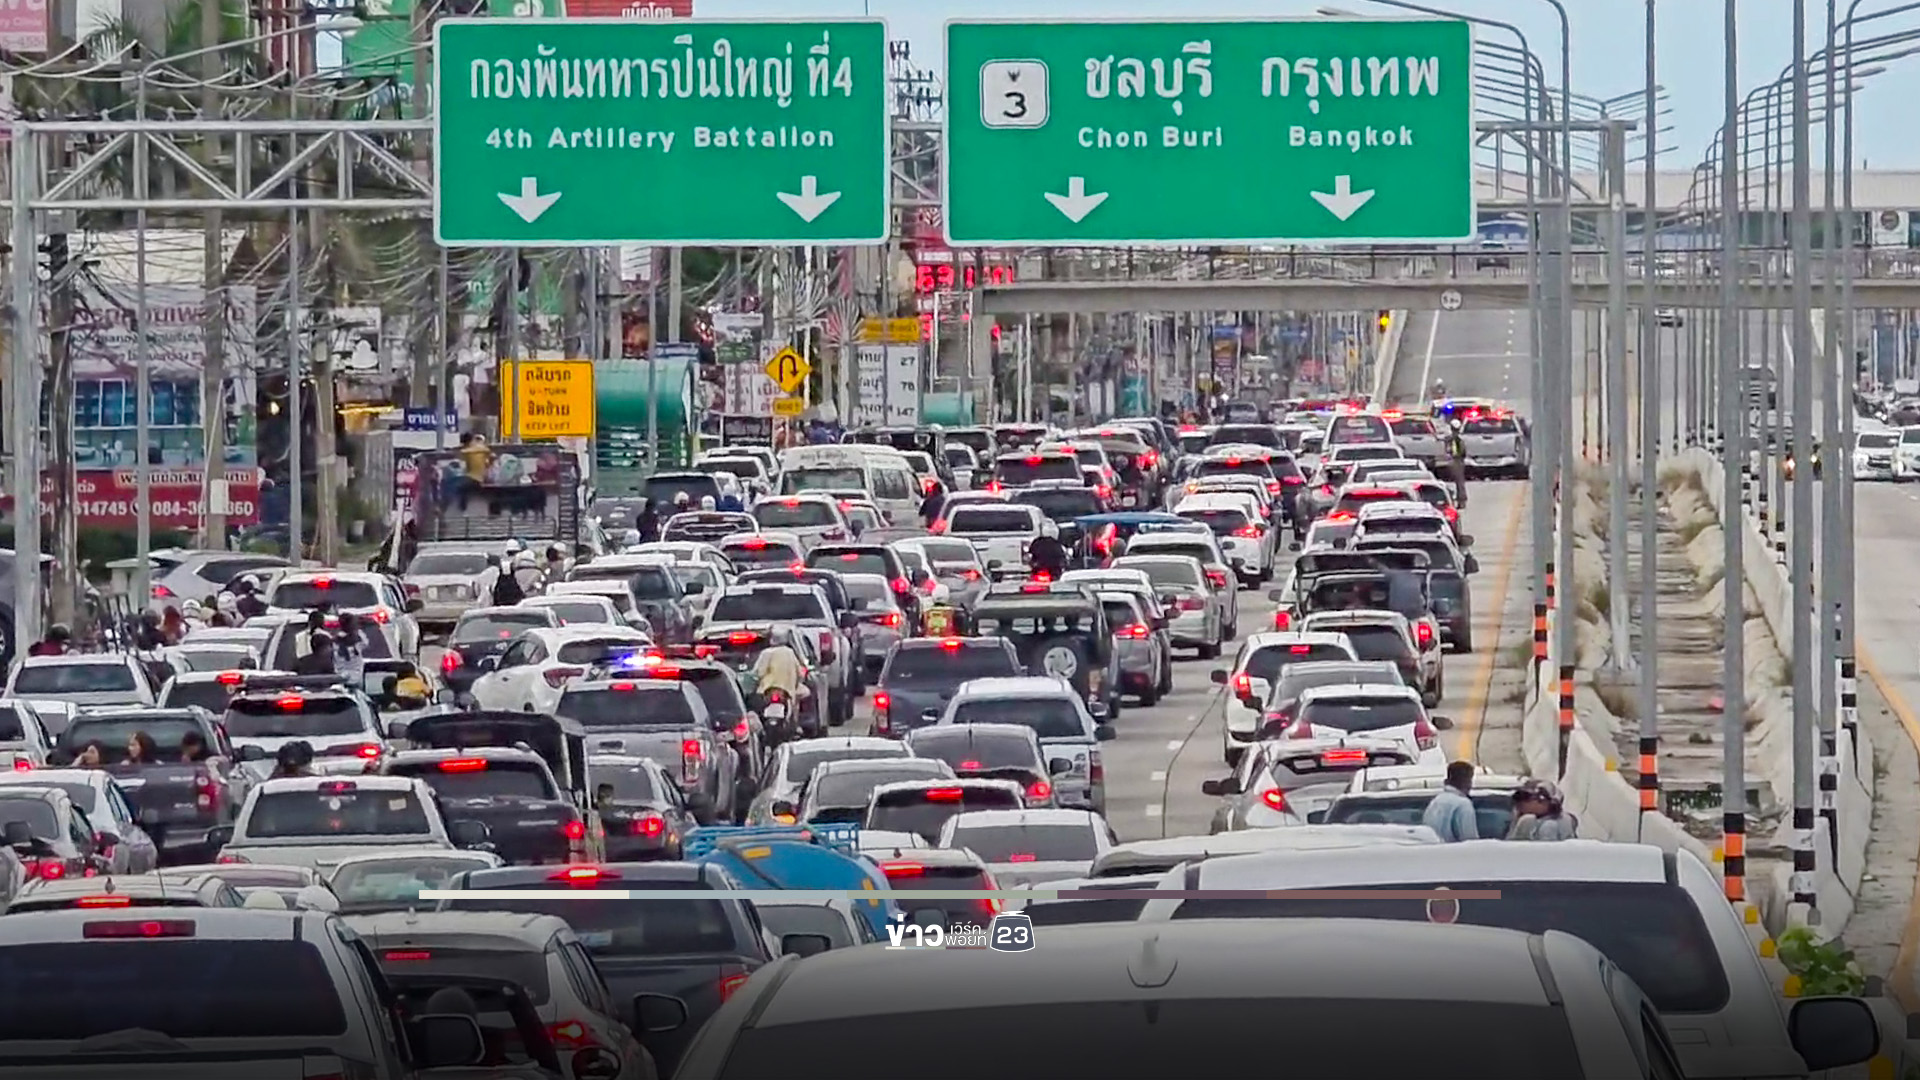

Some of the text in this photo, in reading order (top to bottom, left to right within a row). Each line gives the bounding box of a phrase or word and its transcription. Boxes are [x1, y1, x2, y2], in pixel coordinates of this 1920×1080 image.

[470, 30, 852, 107] กองพันทหารปืนใหญ่ ที่4
[1084, 39, 1440, 116] ชลบุรี กรุงเทพ
[1003, 92, 1027, 118] 3
[486, 126, 834, 153] 4th Artillery Battalion
[1078, 125, 1414, 152] Chon Buri Bangkok
